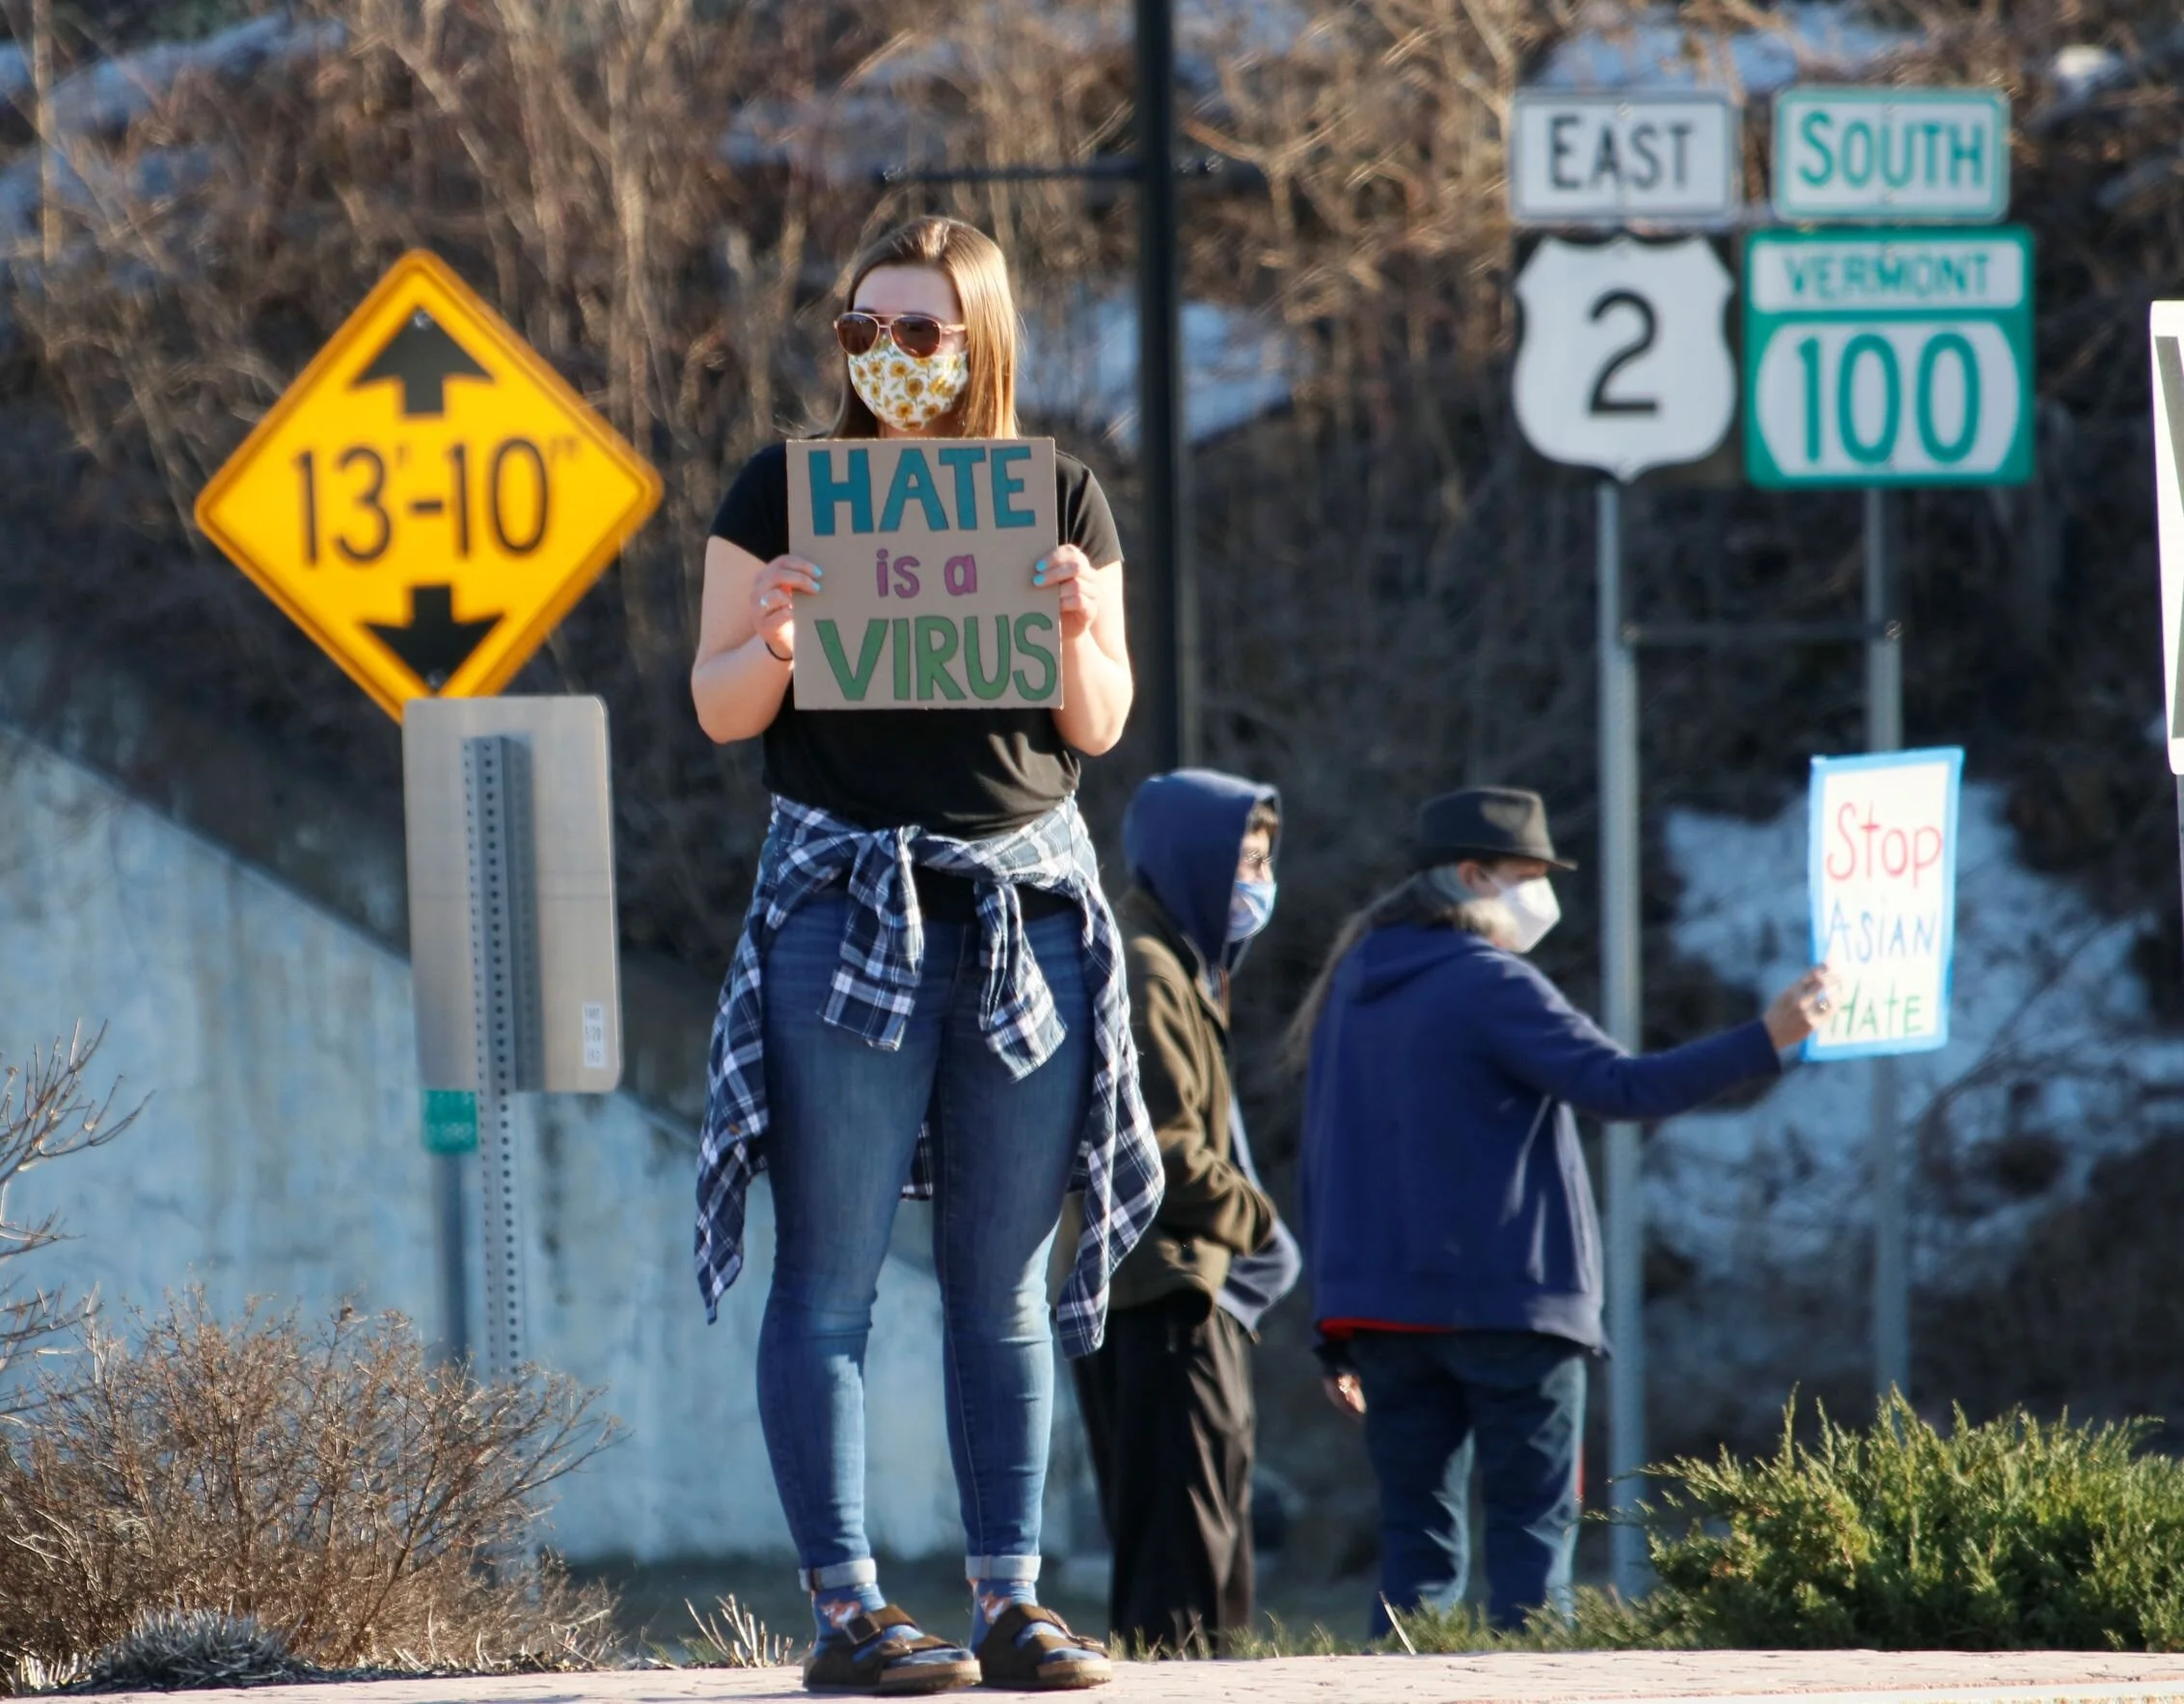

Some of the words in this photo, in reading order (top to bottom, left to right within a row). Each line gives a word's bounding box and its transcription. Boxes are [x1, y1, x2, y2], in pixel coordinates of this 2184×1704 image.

[1549, 114, 1695, 191] EAST
[1798, 112, 1985, 186] SOUTH
[1785, 254, 1991, 296] VERMONT
[1587, 289, 1659, 419] 2
[1799, 333, 1980, 465] 100
[807, 446, 1036, 536] HATE
[876, 548, 921, 599] is
[943, 554, 978, 597] a
[813, 612, 1057, 702] VIRUS
